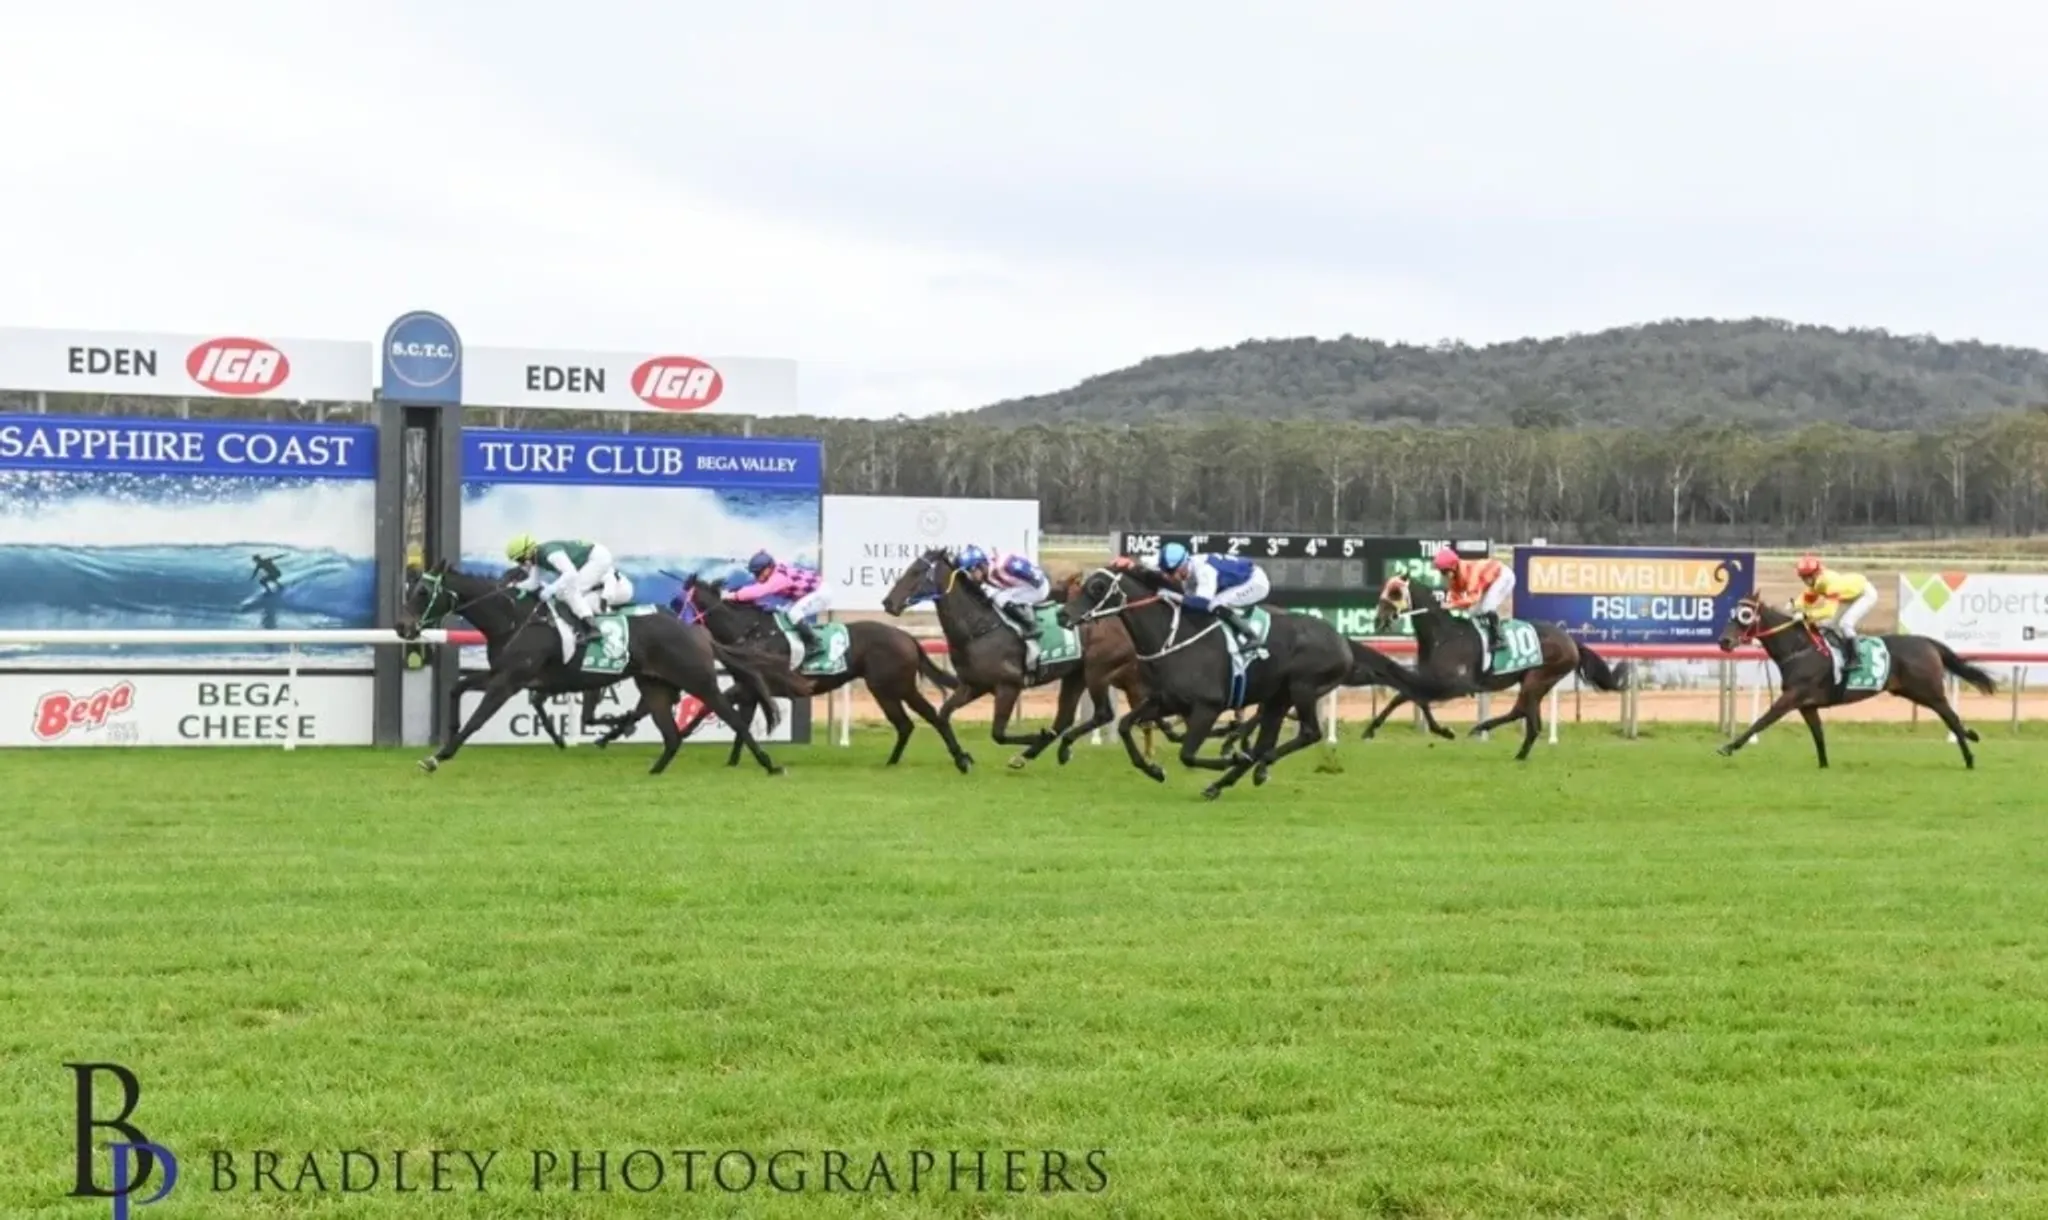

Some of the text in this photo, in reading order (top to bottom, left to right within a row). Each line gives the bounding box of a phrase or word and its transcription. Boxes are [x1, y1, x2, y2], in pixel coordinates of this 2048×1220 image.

[68, 347, 157, 376] EDEN
[392, 341, 453, 358] S.C.T.C.
[195, 347, 283, 385] IGA
[526, 365, 605, 393] EDEN
[638, 365, 714, 399] IGA
[0, 426, 354, 466] SAPPHIRE COAST
[479, 442, 683, 476] TURF CLUB
[696, 455, 798, 473] BEGA VALLEY
[1126, 536, 1160, 553] RACE
[1533, 563, 1712, 591] MERIMBULA
[1591, 597, 1714, 621] RSL CLUB
[1505, 627, 1537, 659] 10
[198, 683, 298, 706] BEGA
[36, 684, 131, 737] Bega
[178, 715, 315, 739] CHEESE
